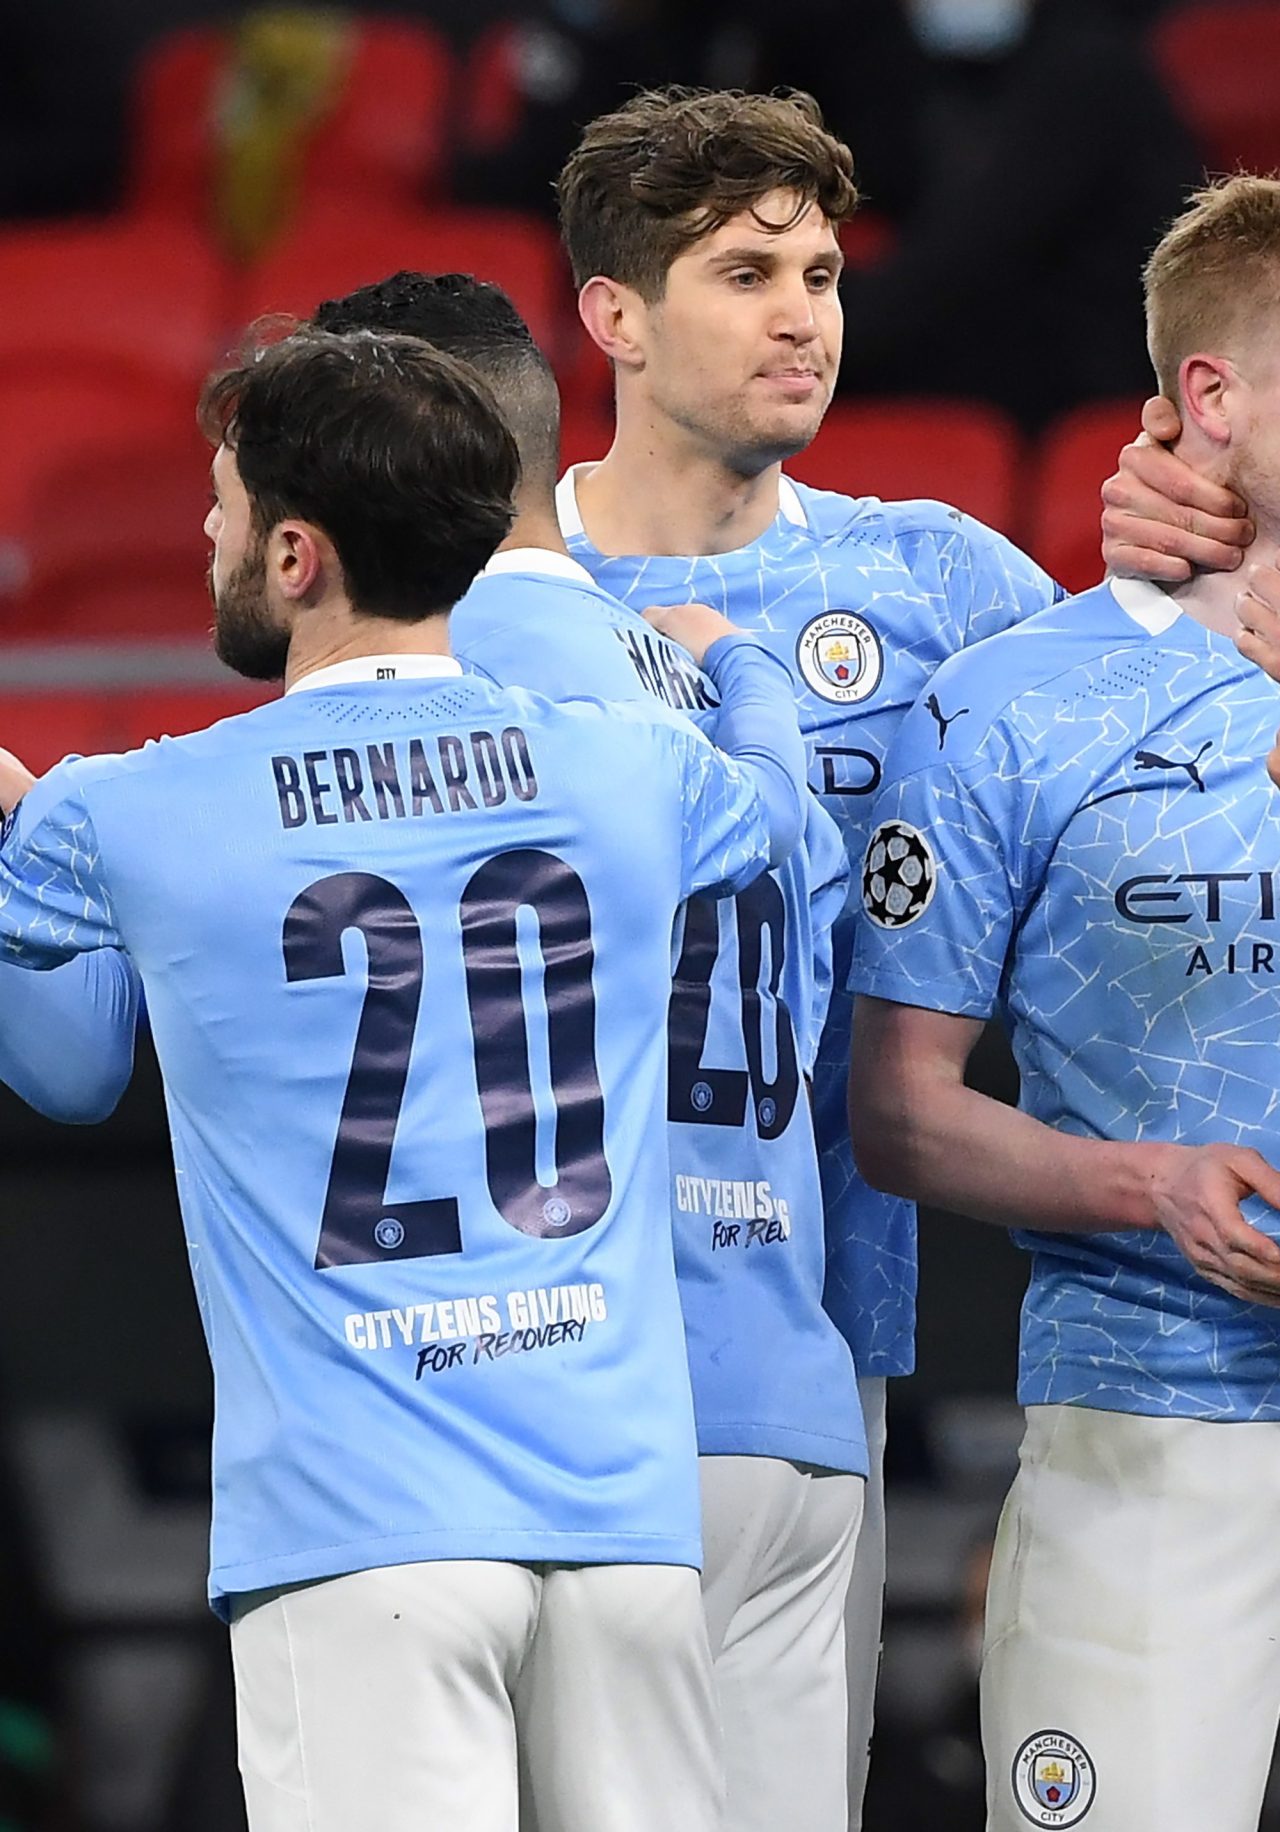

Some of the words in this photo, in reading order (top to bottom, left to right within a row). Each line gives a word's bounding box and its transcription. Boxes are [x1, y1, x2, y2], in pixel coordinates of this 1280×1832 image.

[804, 617, 872, 649] MANCHESTER
[835, 689, 858, 699] CITY
[271, 726, 539, 830] BERNARDO
[282, 848, 613, 1271] 20
[676, 1174, 775, 1219] CITYZENS
[711, 1220, 741, 1252] FOR
[344, 1294, 501, 1350] CITYZENS
[507, 1283, 608, 1331] GIVING
[415, 1344, 467, 1382] FOR
[473, 1316, 587, 1365] RECOVERY
[1022, 1736, 1087, 1771] MANCHESTER
[1040, 1812, 1065, 1823] CITY
